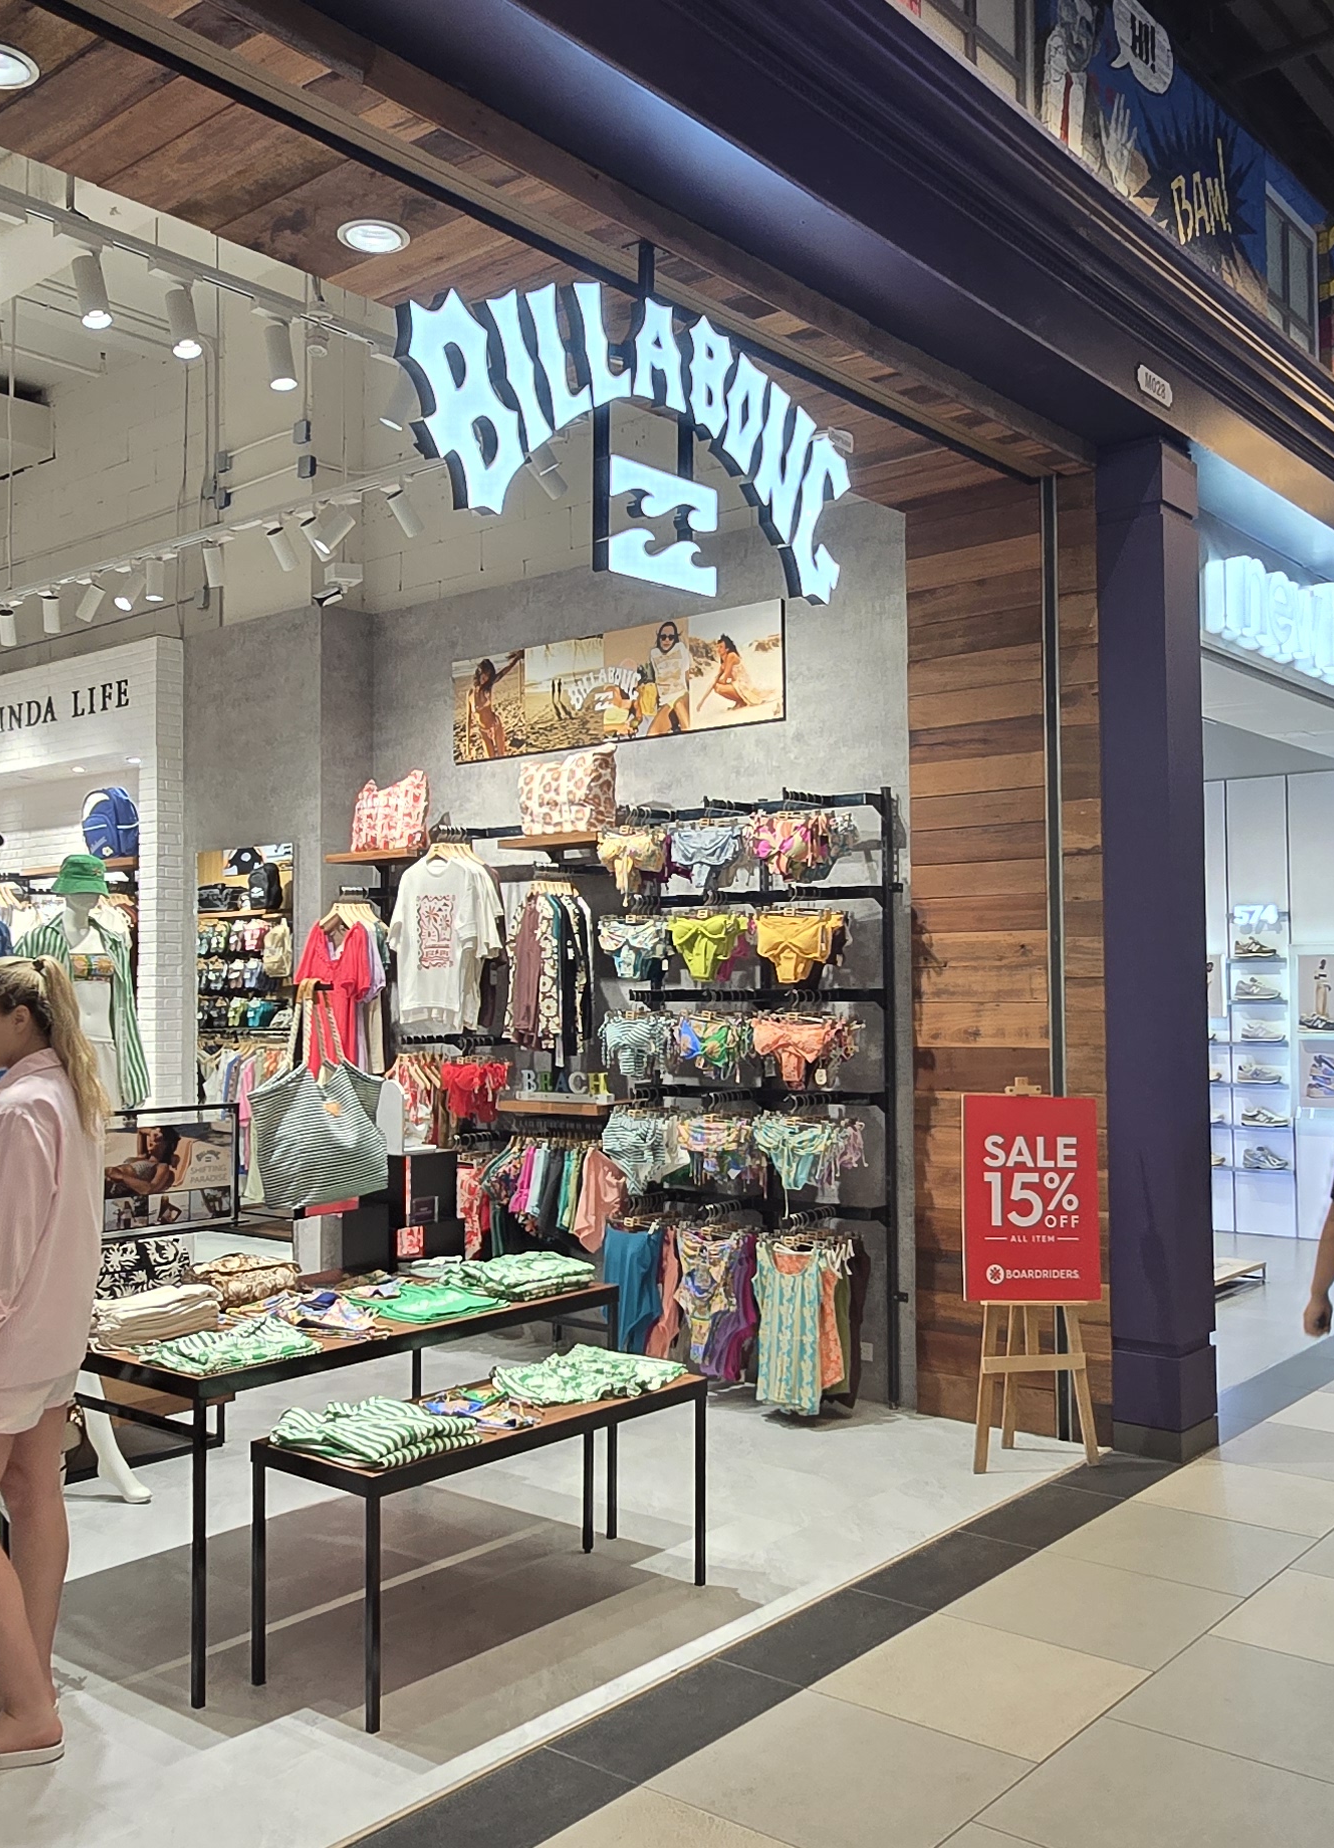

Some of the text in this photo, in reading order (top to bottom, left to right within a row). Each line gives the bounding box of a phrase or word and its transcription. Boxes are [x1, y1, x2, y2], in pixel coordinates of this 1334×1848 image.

[1130, 12, 1156, 74] HI!
[1171, 137, 1232, 246] BAM!
[398, 281, 852, 606] BILLABONG
[71, 679, 130, 718] LIFE
[1233, 904, 1279, 925] 574
[983, 1135, 1078, 1168] SALE
[983, 1171, 1080, 1227] 15%
[1010, 1234, 1056, 1242] ALL ITEM
[1044, 1214, 1080, 1228] OFF
